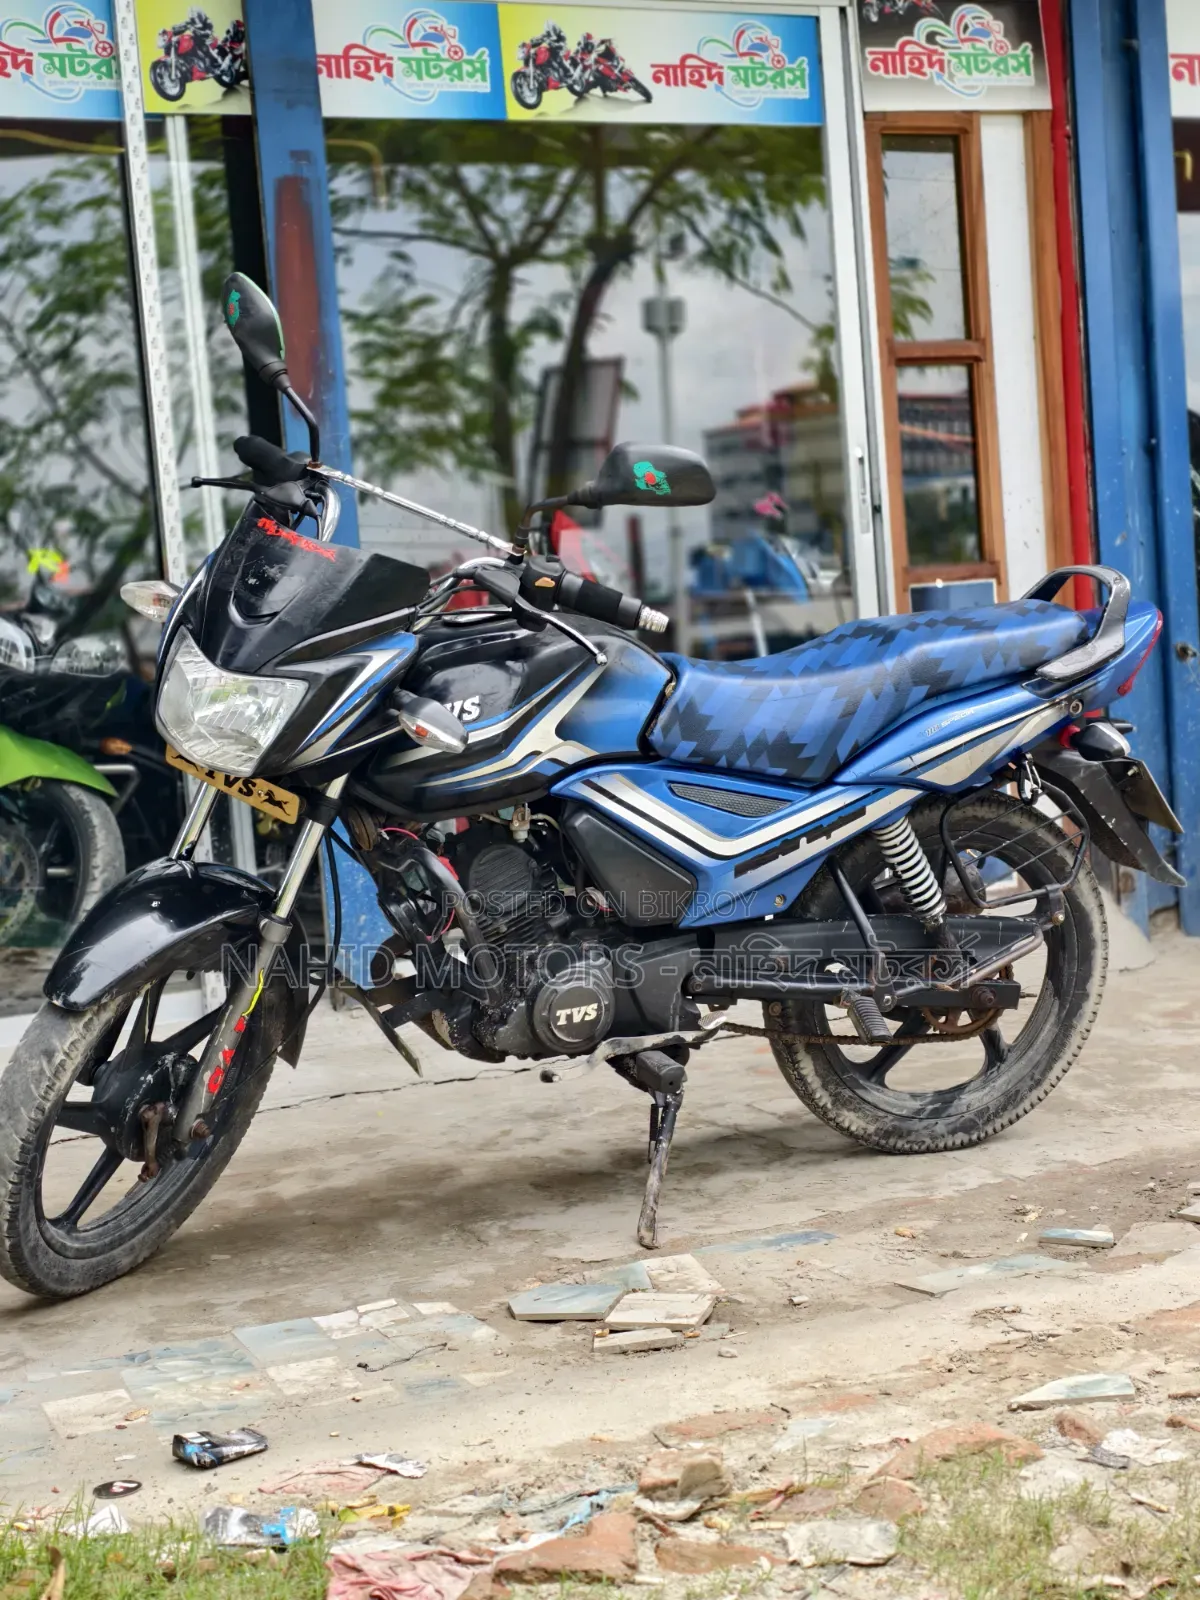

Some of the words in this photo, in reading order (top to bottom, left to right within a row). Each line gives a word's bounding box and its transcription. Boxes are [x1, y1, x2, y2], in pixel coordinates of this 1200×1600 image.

[37, 43, 117, 80] মটর
[650, 53, 725, 89] নাহিদ
[867, 39, 945, 77] নাহিদ
[555, 1002, 598, 1026] TVS
